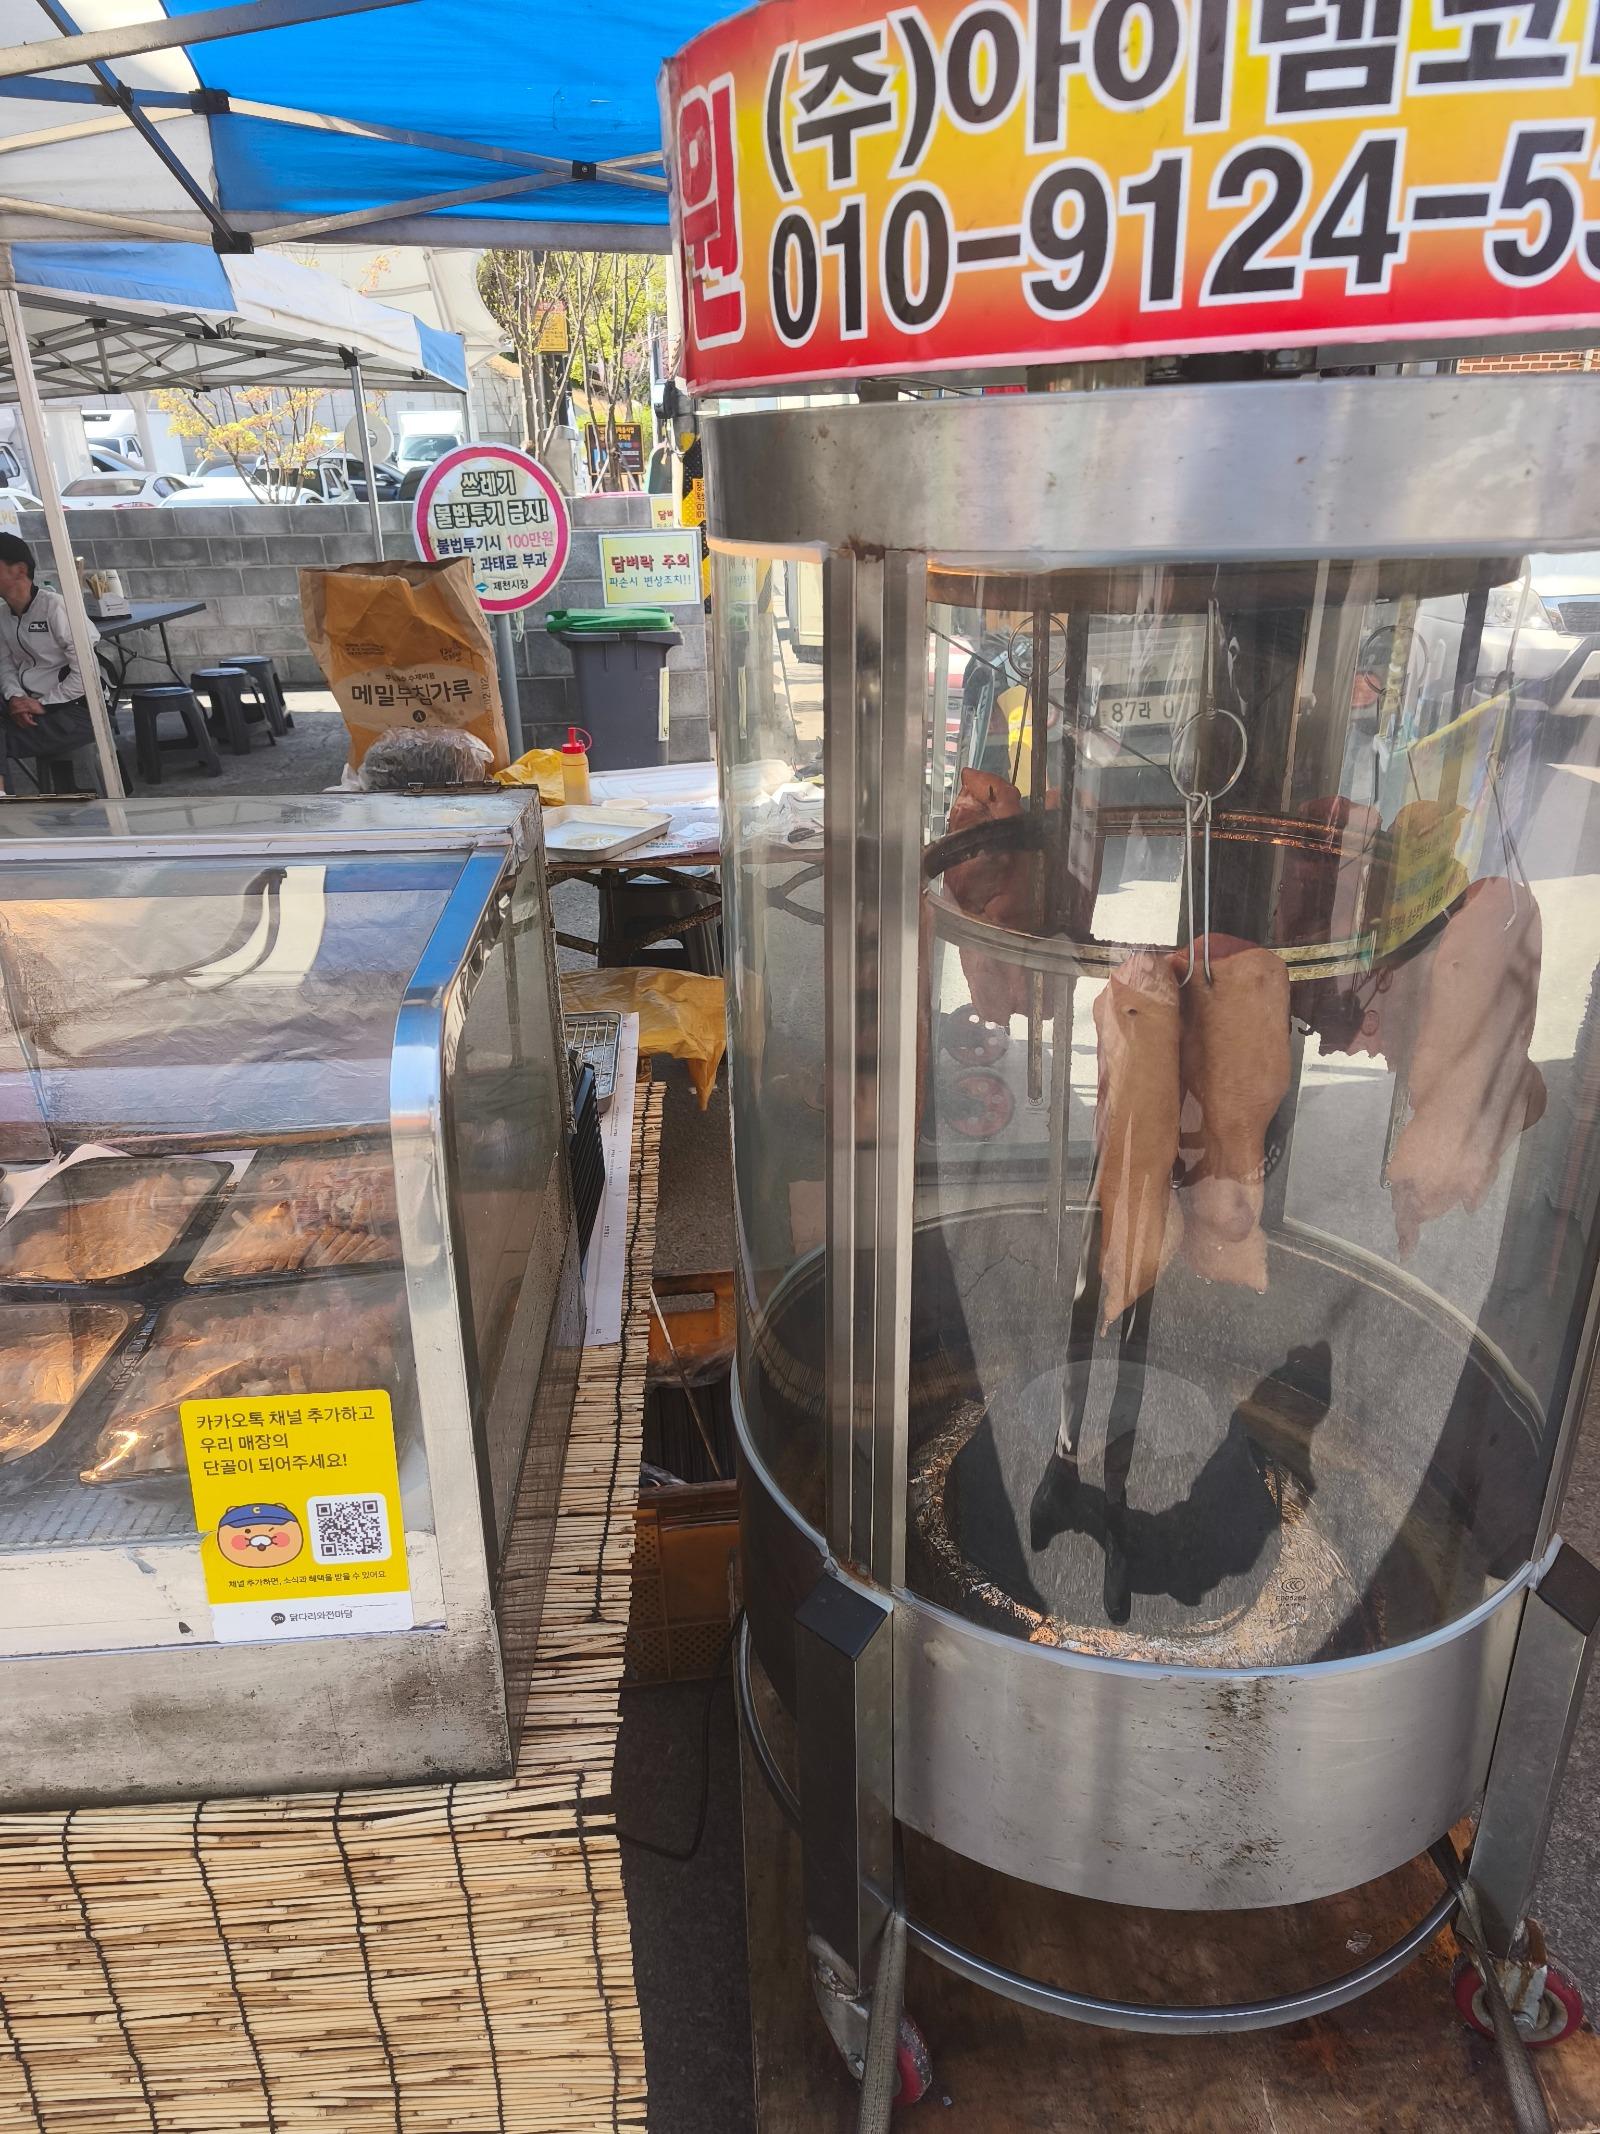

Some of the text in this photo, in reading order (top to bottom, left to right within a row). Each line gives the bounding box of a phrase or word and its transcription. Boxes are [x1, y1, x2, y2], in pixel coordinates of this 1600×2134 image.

[764, 0, 1600, 192] (주)아이템코
[771, 130, 1600, 342] 010-9124-5
[461, 470, 516, 497] 쓰레기
[434, 499, 549, 529] 불법투기 금지!
[437, 531, 554, 554] 불법투기시 100만원
[480, 556, 518, 572] 과태료
[523, 553, 547, 568] 부과
[611, 554, 690, 573] 담벼락 주의
[493, 580, 528, 591] 제천시장
[609, 576, 638, 588] 파손시
[196, 1406, 375, 1430] 카카오톡 채널 추가하고
[200, 1433, 289, 1453] 우리 매장의
[203, 1453, 347, 1476] 단골이 되어주세요!
[335, 1572, 350, 1581] 받을
[353, 1571, 360, 1580] 수
[362, 1571, 385, 1579] 있어요
